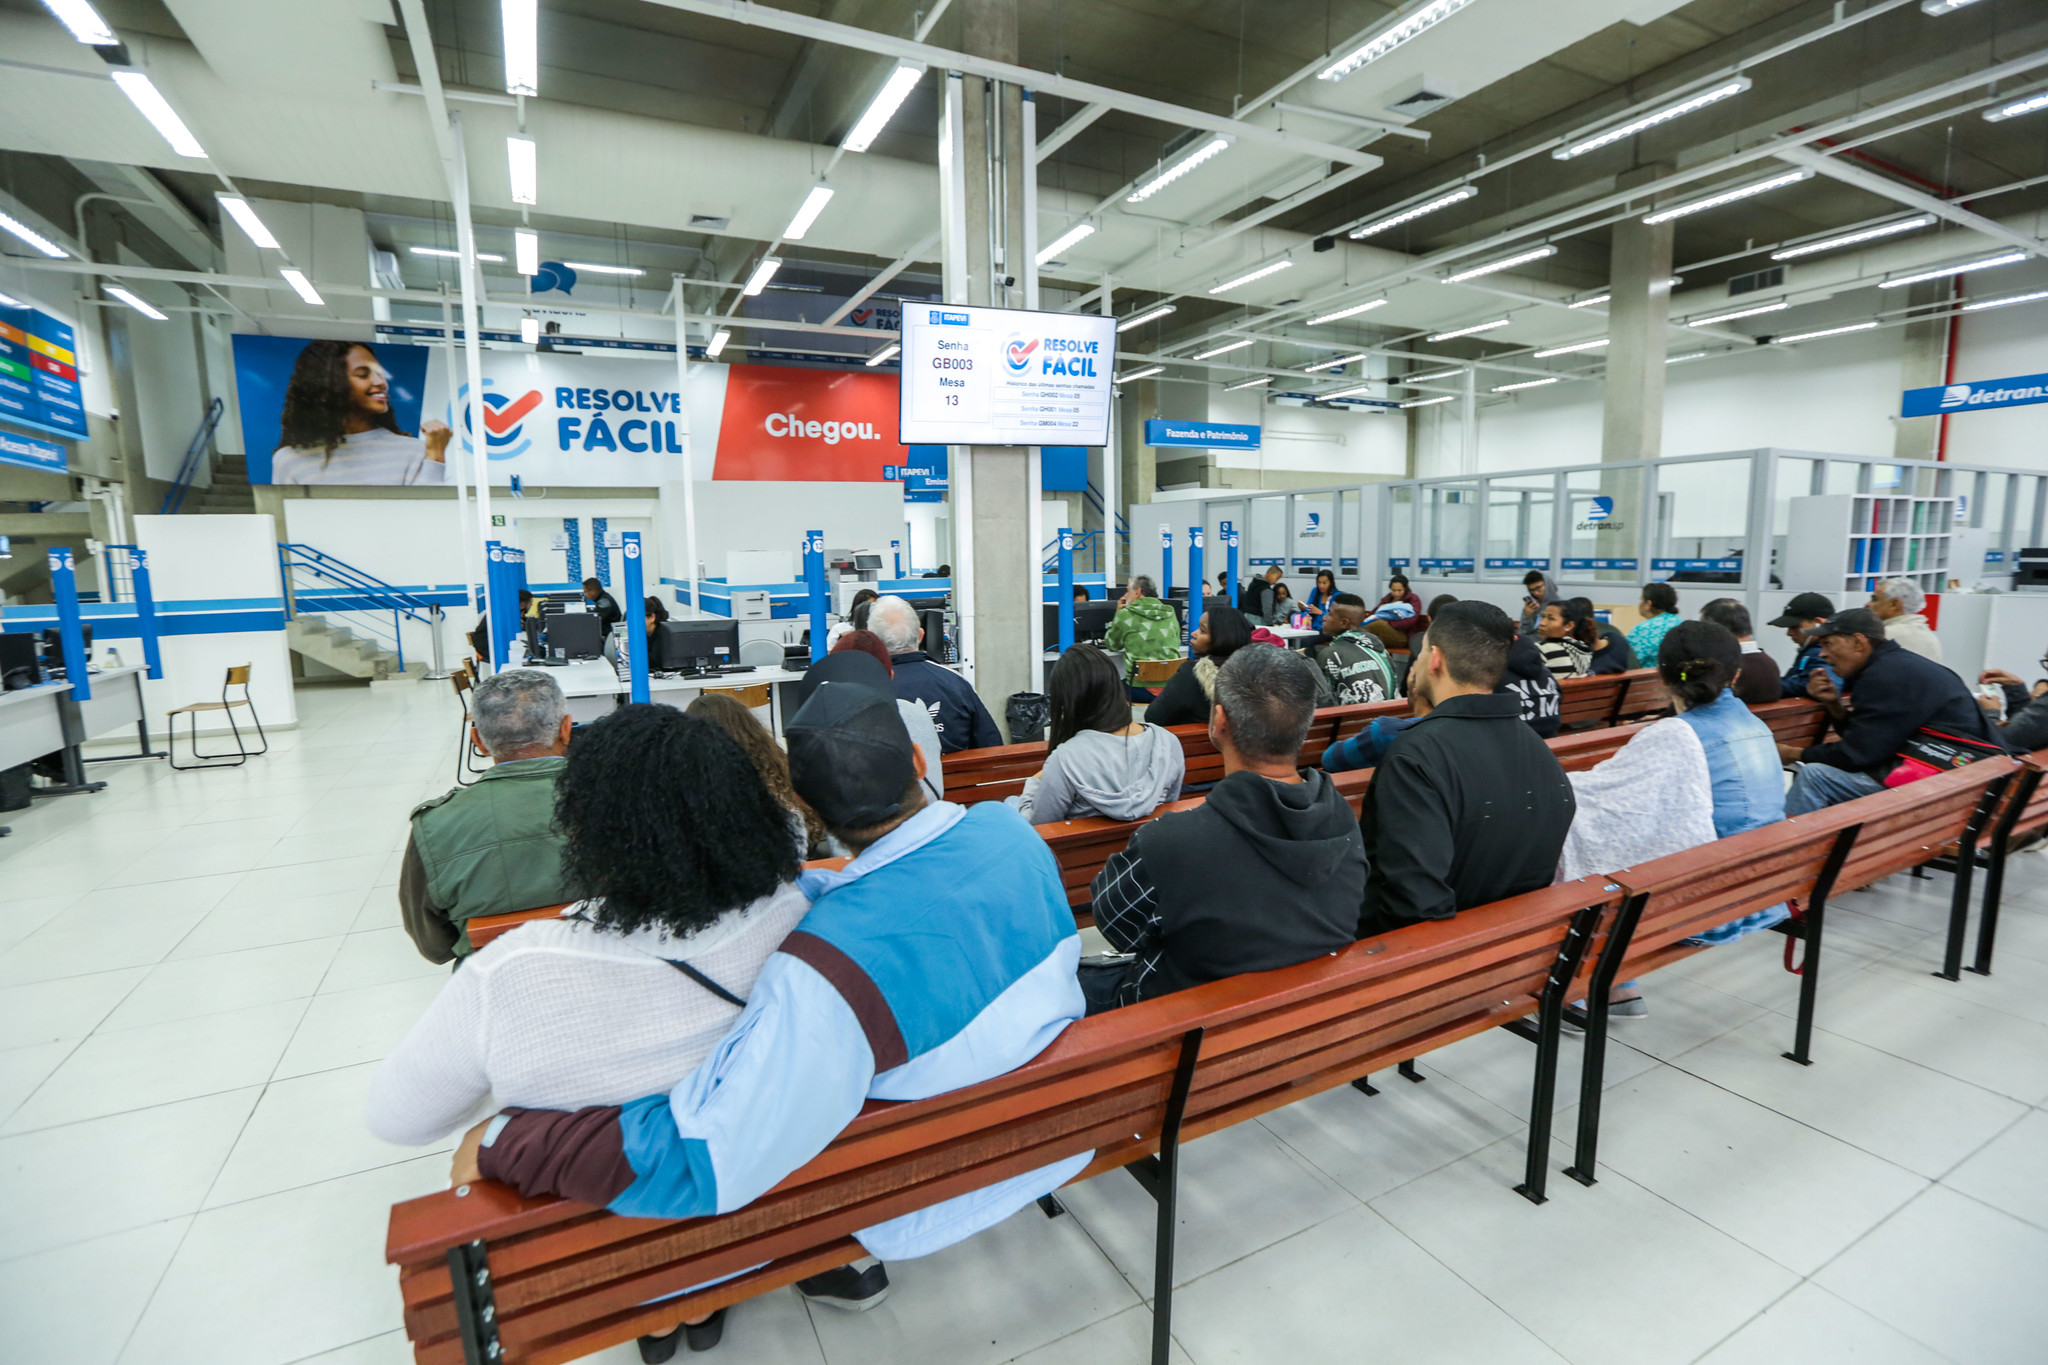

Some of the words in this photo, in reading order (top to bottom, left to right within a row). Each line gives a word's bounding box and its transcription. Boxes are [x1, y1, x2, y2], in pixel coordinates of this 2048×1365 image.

[943, 314, 968, 322] ITAPEVI
[937, 339, 969, 351] Senha
[1043, 338, 1099, 354] RESOLVE
[932, 357, 973, 370] GB003
[1042, 353, 1097, 377] FÁCIL
[939, 377, 965, 387] Mesa
[555, 387, 681, 413] RESOLVE
[945, 395, 959, 406] 13
[557, 411, 682, 453] FÁCIL
[764, 412, 881, 445] Chegou.
[1165, 428, 1199, 439] Fazenda
[1200, 431, 1206, 439] e
[1206, 430, 1249, 441] Patrimônio
[900, 468, 930, 476] ITAPEVI
[627, 546, 637, 554] 14
